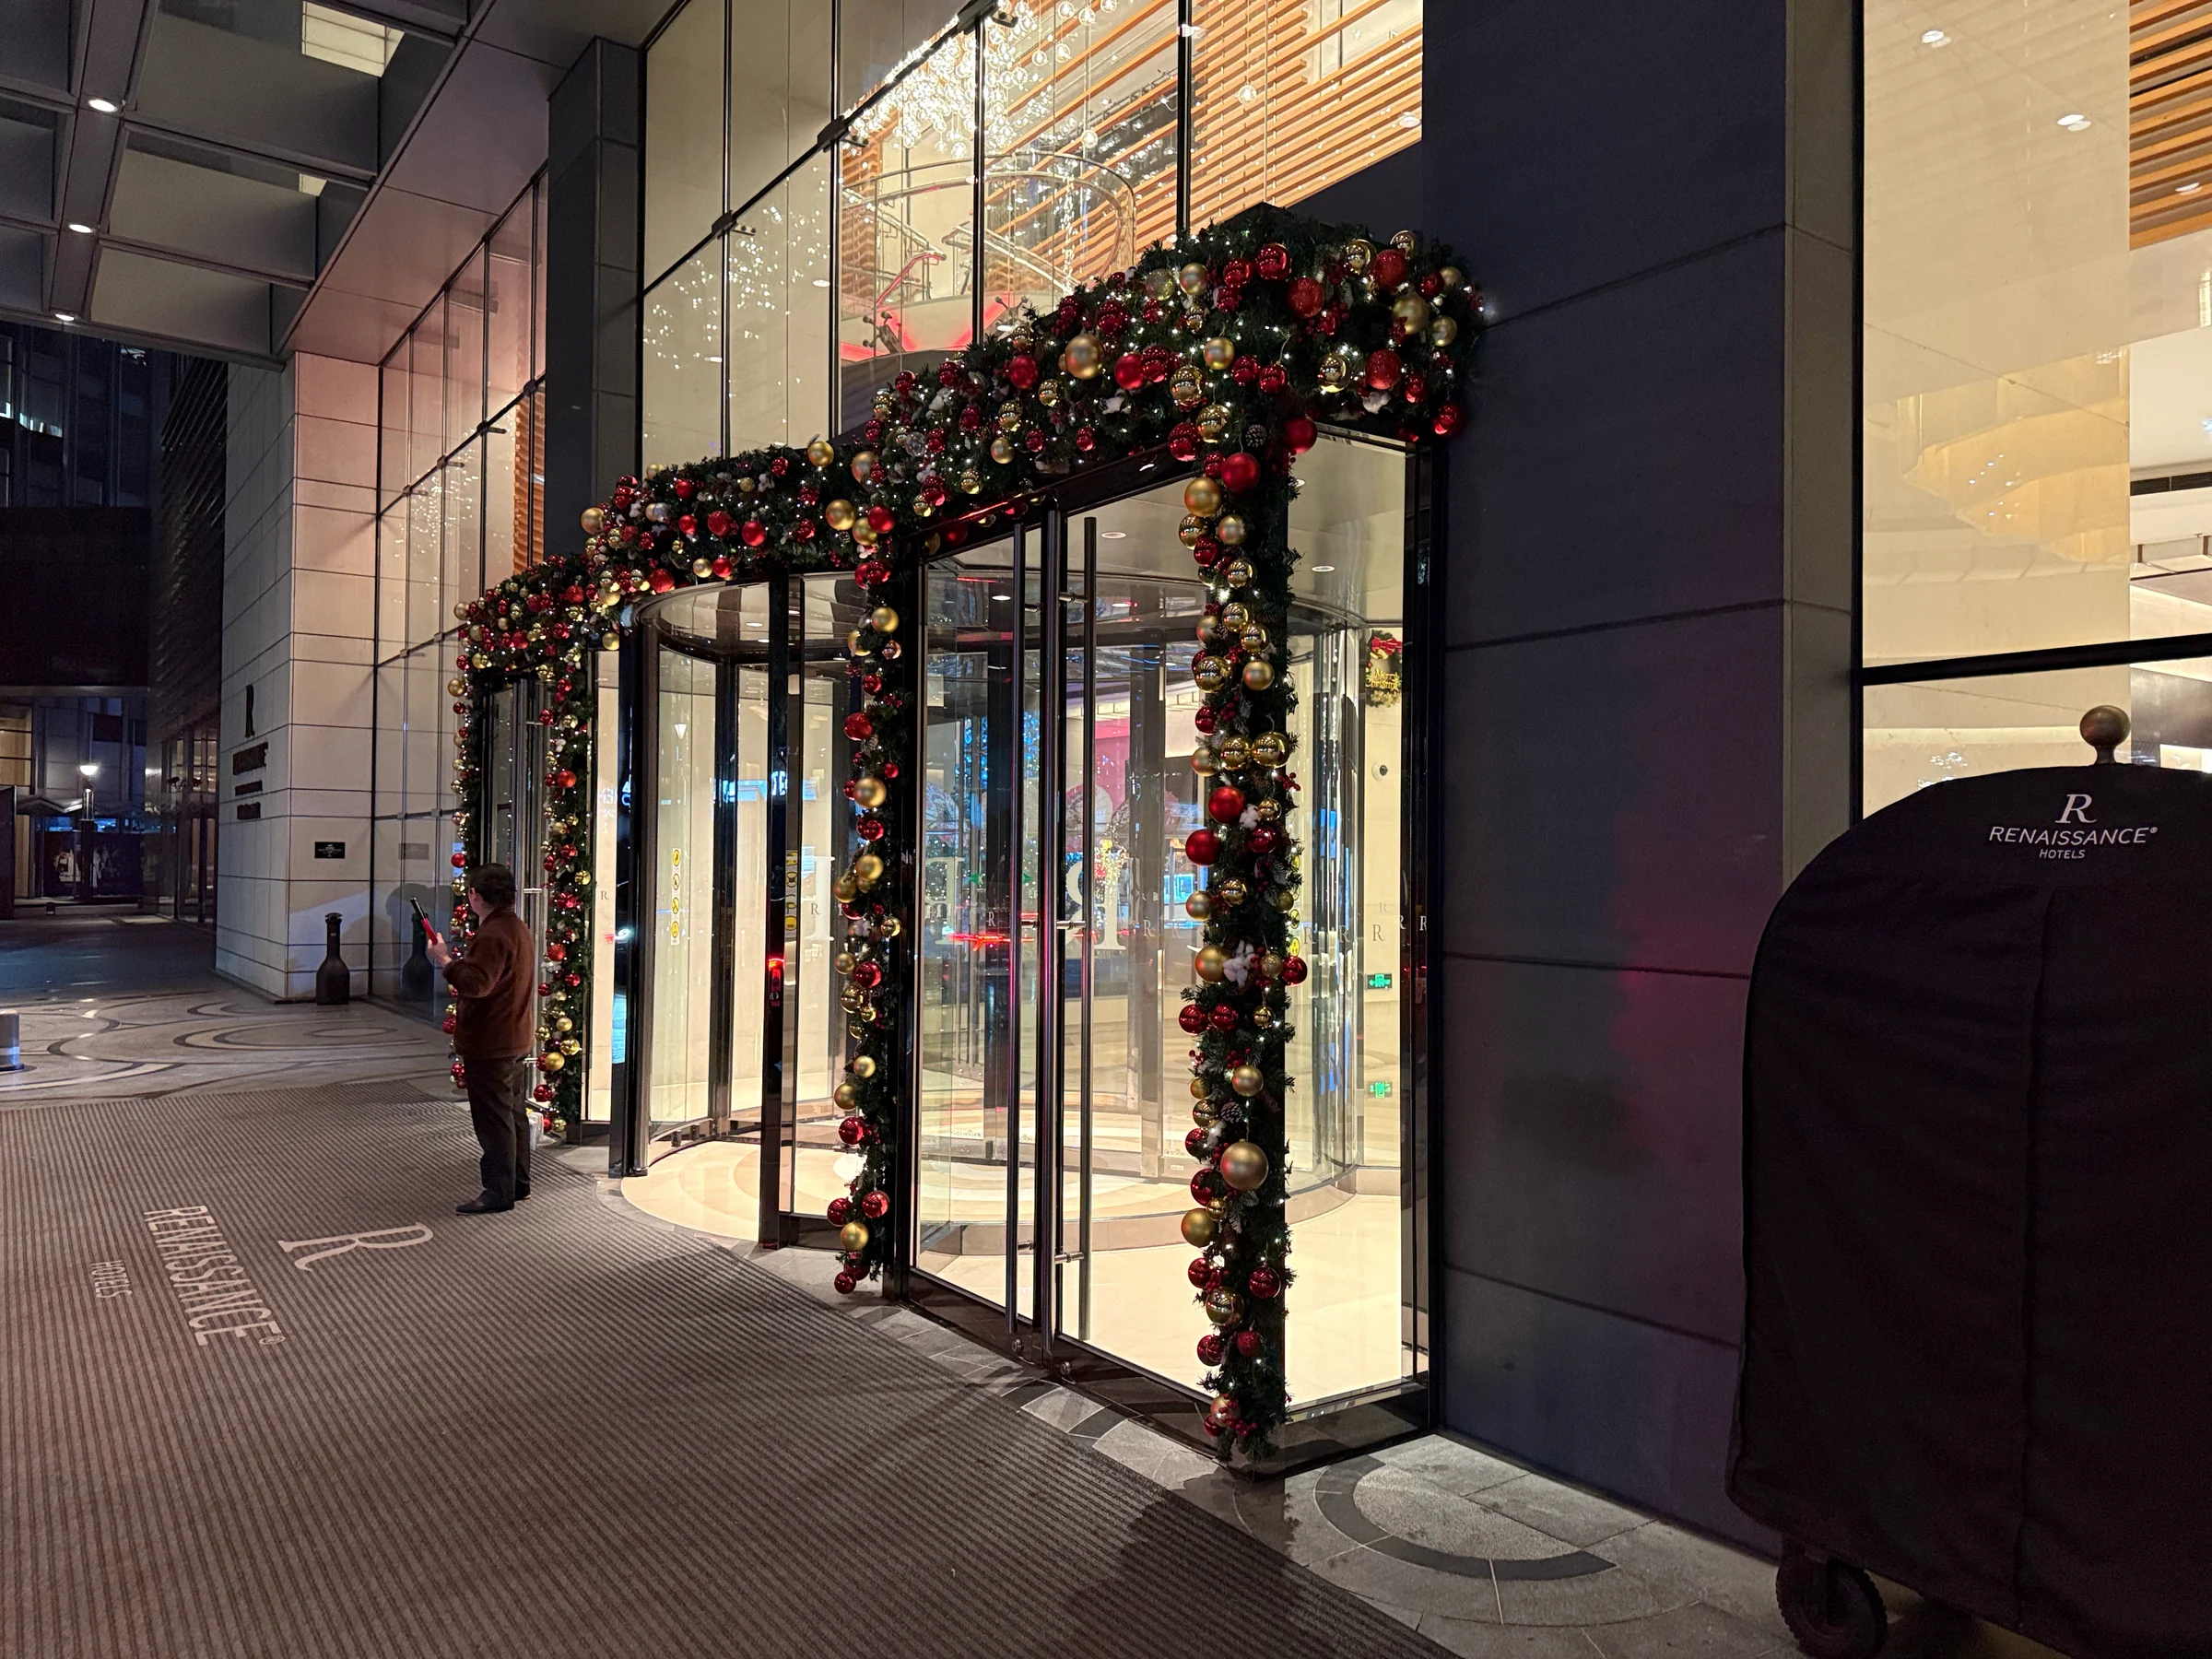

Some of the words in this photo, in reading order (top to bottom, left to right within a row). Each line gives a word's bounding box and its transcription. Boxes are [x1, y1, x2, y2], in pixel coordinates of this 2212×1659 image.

[2054, 794, 2098, 824] R
[2039, 848, 2086, 859] HOTELS
[600, 890, 609, 901] R
[810, 903, 821, 915] R
[988, 911, 996, 927] R
[1143, 919, 1155, 937] R
[1303, 926, 1316, 945] R
[1339, 924, 1352, 943] R
[1372, 924, 1384, 942] R
[278, 1222, 434, 1272] R
[91, 1259, 133, 1299] HOTELS
